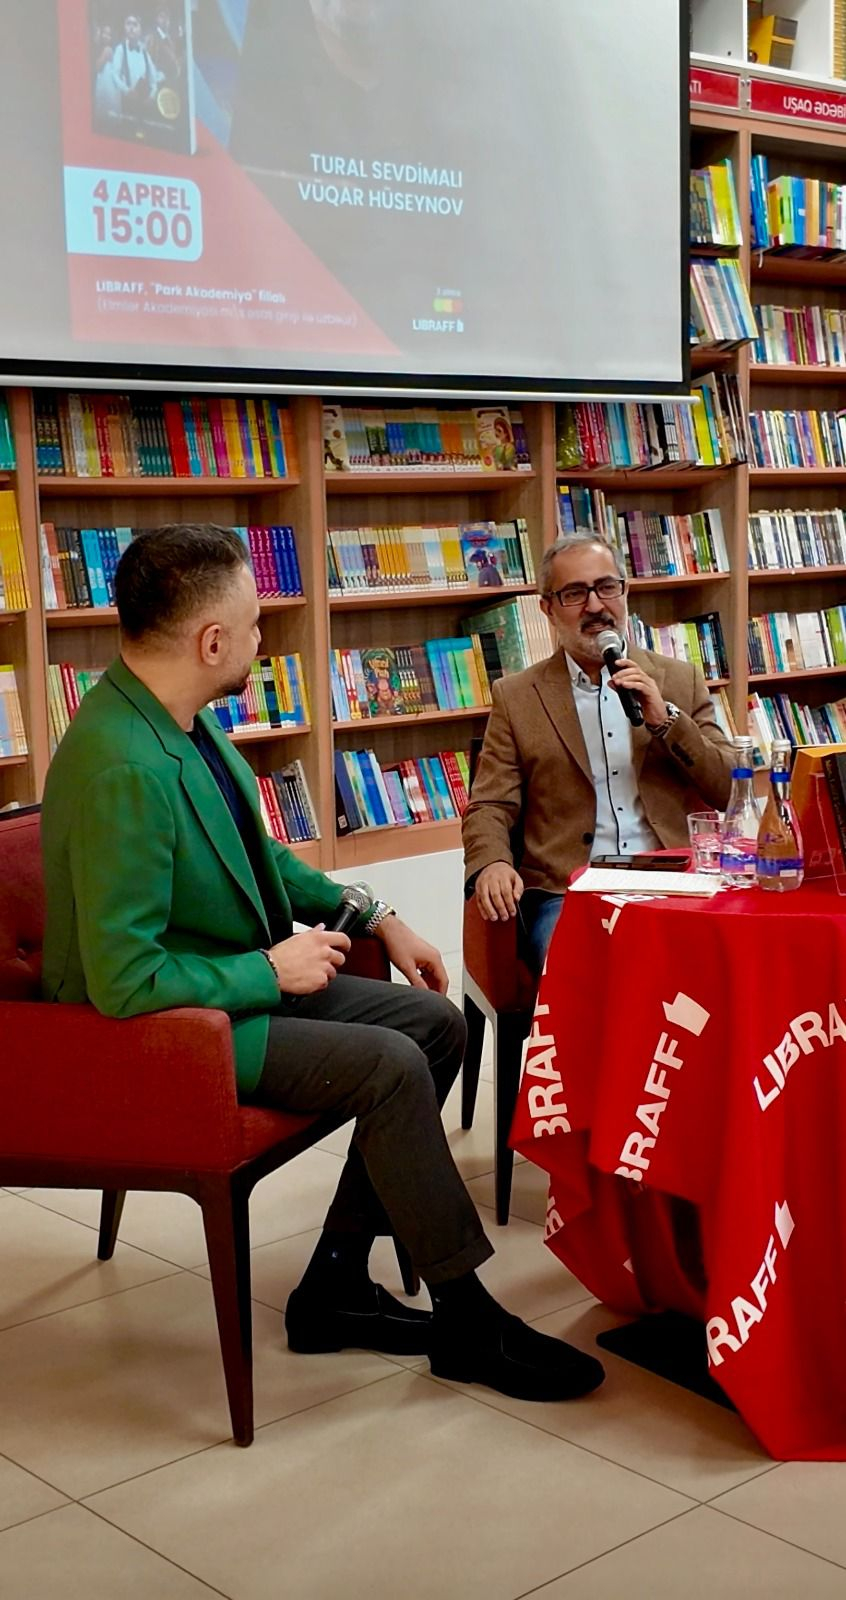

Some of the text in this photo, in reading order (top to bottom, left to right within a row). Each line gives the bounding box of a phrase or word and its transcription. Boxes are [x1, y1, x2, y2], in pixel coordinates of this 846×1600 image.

[783, 96, 812, 114] UŞAQ
[310, 153, 463, 189] TURAL SEVDİMALI
[93, 179, 191, 212] 4 APREL
[298, 178, 464, 216] VÜQAR HÜSEYNOV
[92, 205, 193, 249] 15:00
[412, 318, 456, 333] LIBRAFF
